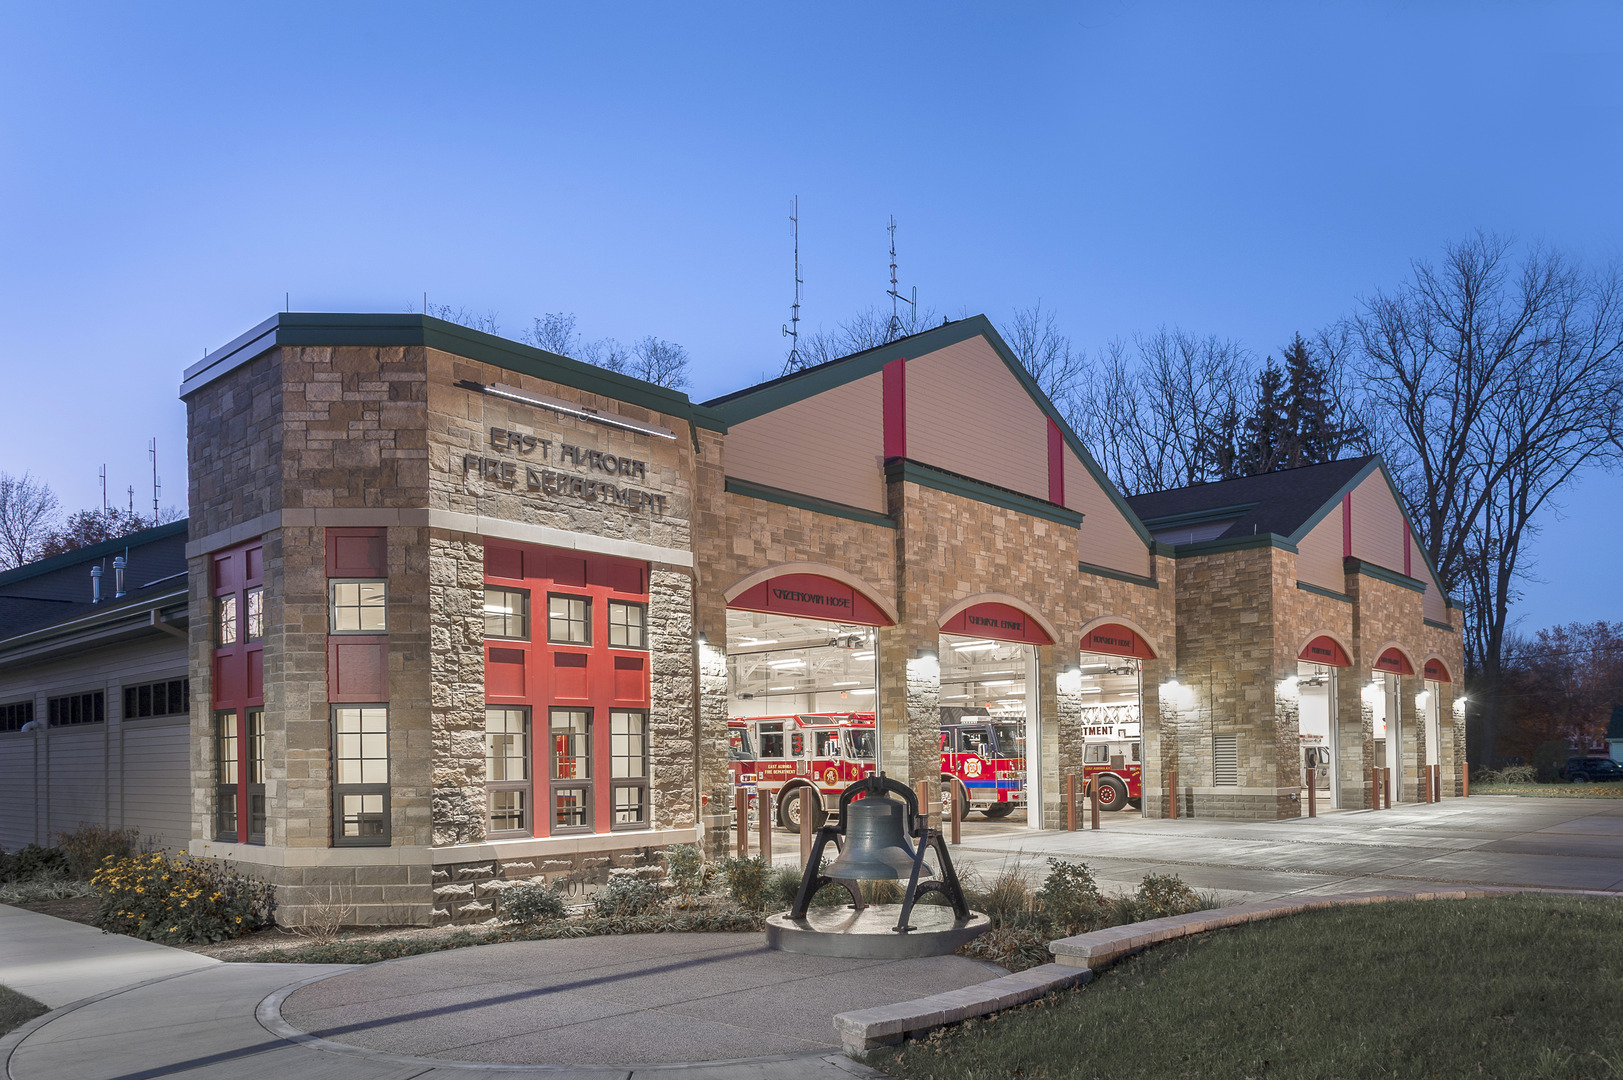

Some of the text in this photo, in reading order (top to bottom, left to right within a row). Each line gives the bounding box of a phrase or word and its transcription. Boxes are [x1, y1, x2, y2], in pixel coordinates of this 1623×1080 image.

[490, 427, 552, 459] EAST
[464, 454, 666, 512] FIRE DEPARTMENT
[826, 596, 851, 608] HOSE
[795, 736, 801, 752] 3
